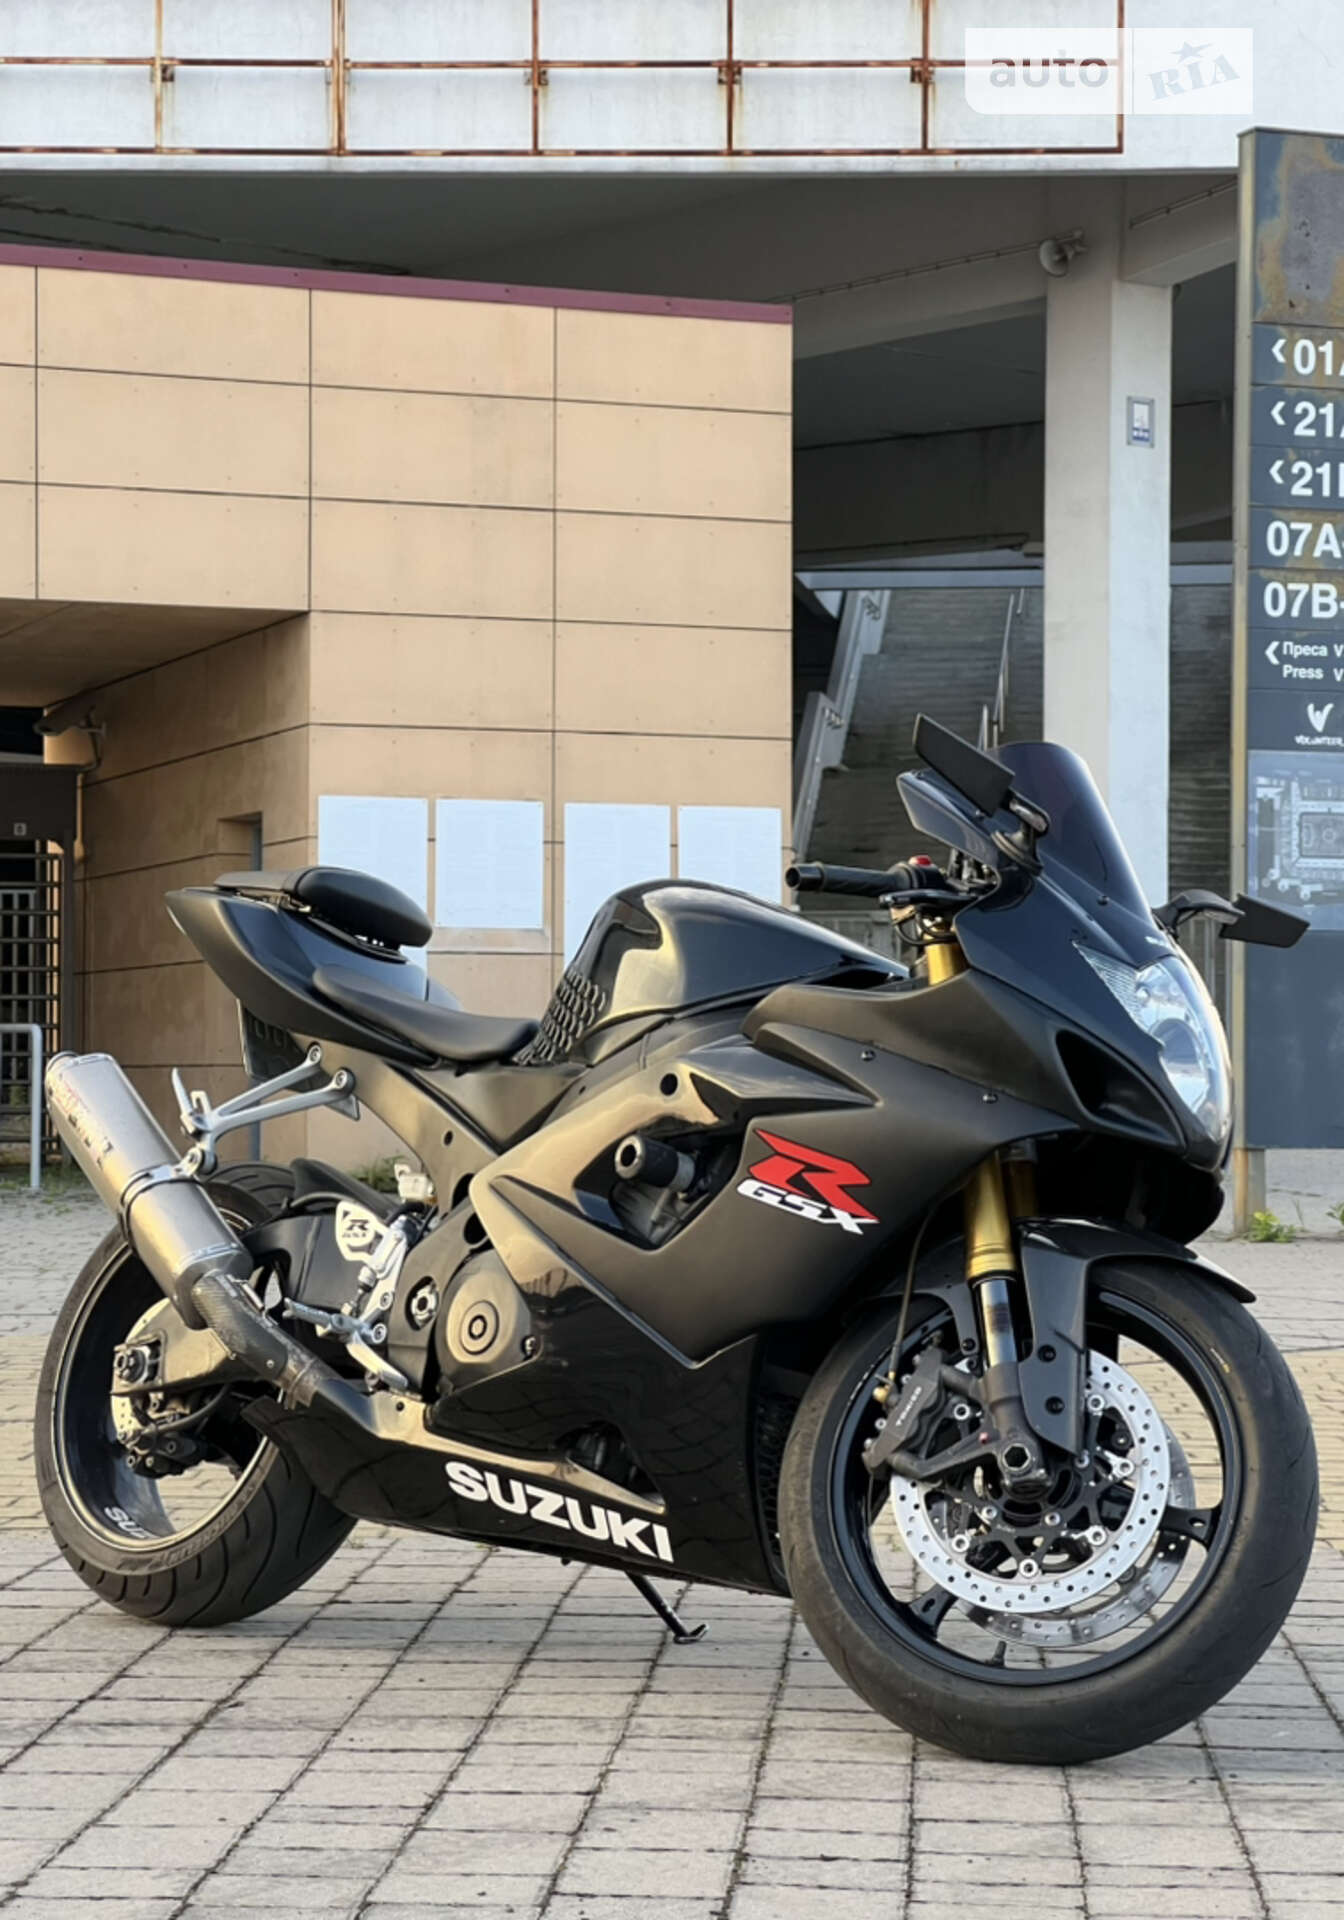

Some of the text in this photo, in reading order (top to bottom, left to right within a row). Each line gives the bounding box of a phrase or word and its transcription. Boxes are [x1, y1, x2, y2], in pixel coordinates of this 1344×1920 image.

[1293, 338, 1344, 376] 01
[1293, 400, 1344, 438] 21
[1290, 461, 1344, 497] 21
[1266, 520, 1344, 558] 07A
[1282, 641, 1328, 658] Преса
[1282, 664, 1324, 680] Press
[445, 1460, 674, 1564] SUZUKI
